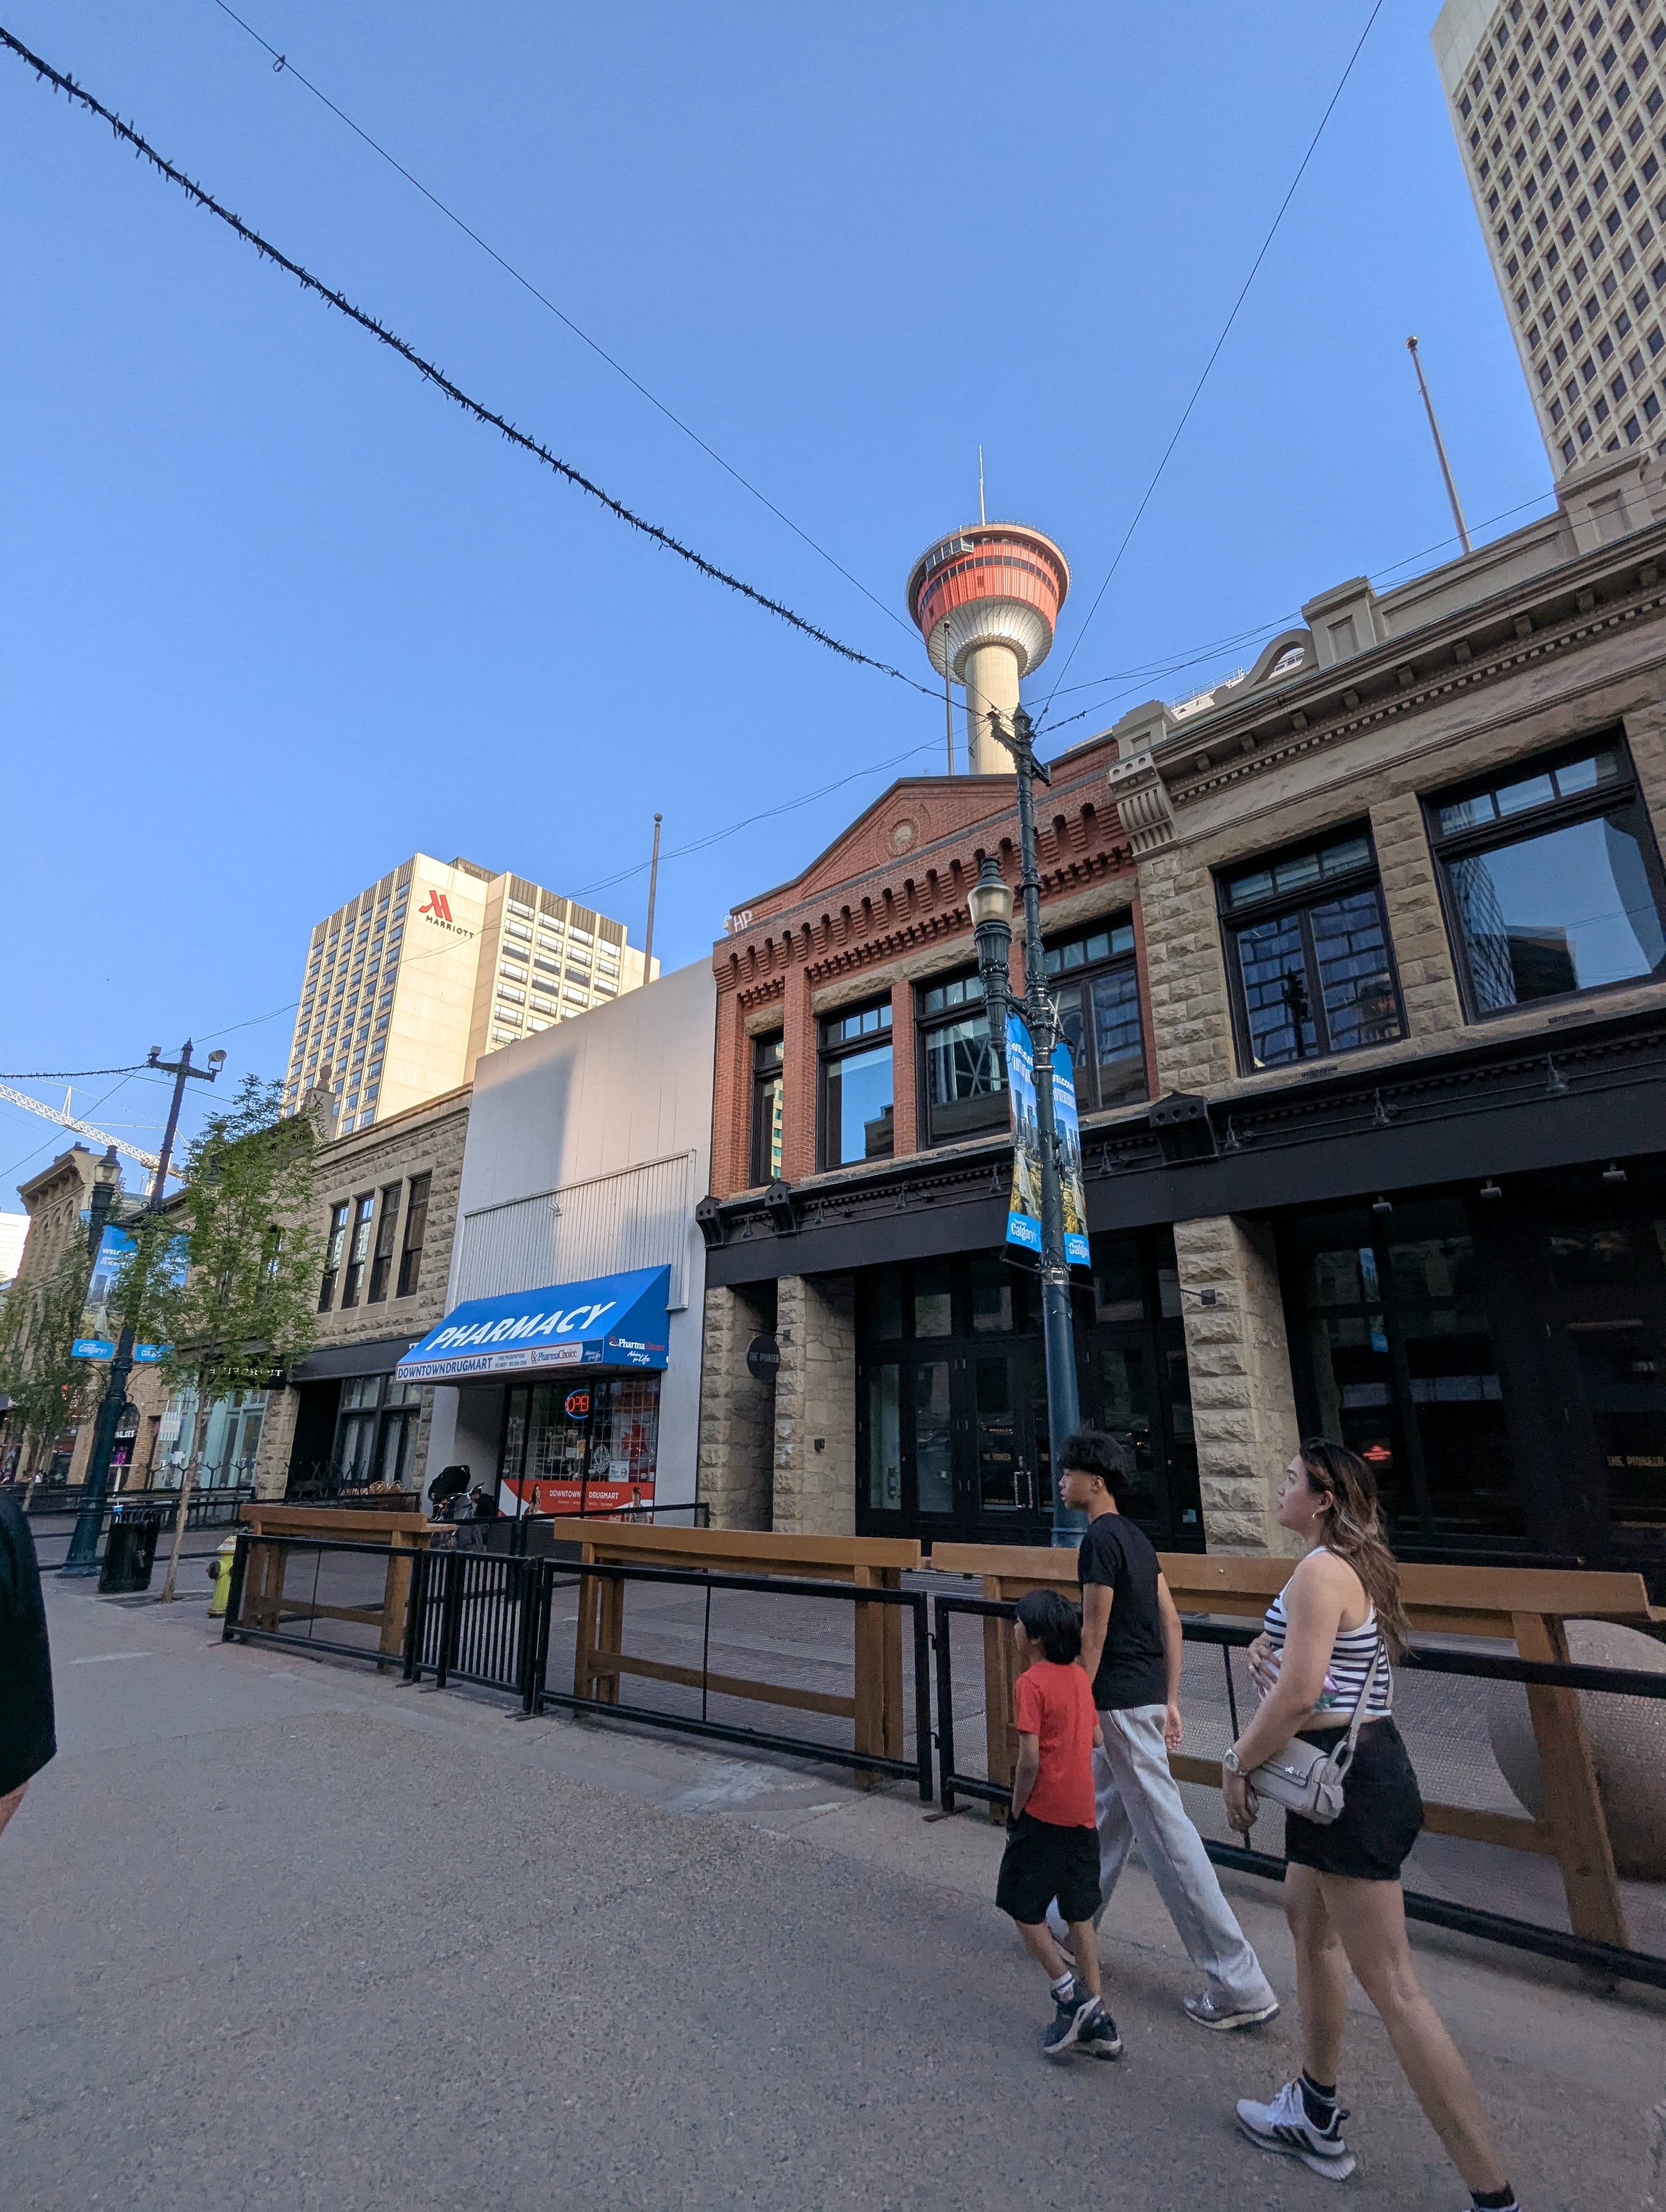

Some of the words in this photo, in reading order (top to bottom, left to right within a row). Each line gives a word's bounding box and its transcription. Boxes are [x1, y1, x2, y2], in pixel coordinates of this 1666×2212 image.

[426, 915, 474, 939] MARRIOTT
[1011, 1223, 1035, 1244] Calgary
[425, 1302, 617, 1351] PHARMACY
[538, 1348, 577, 1361] PharmaChoice
[749, 1352, 759, 1361] THE
[549, 1490, 581, 1498] DOWNTOWN
[589, 1491, 619, 1500] DRUGMART
